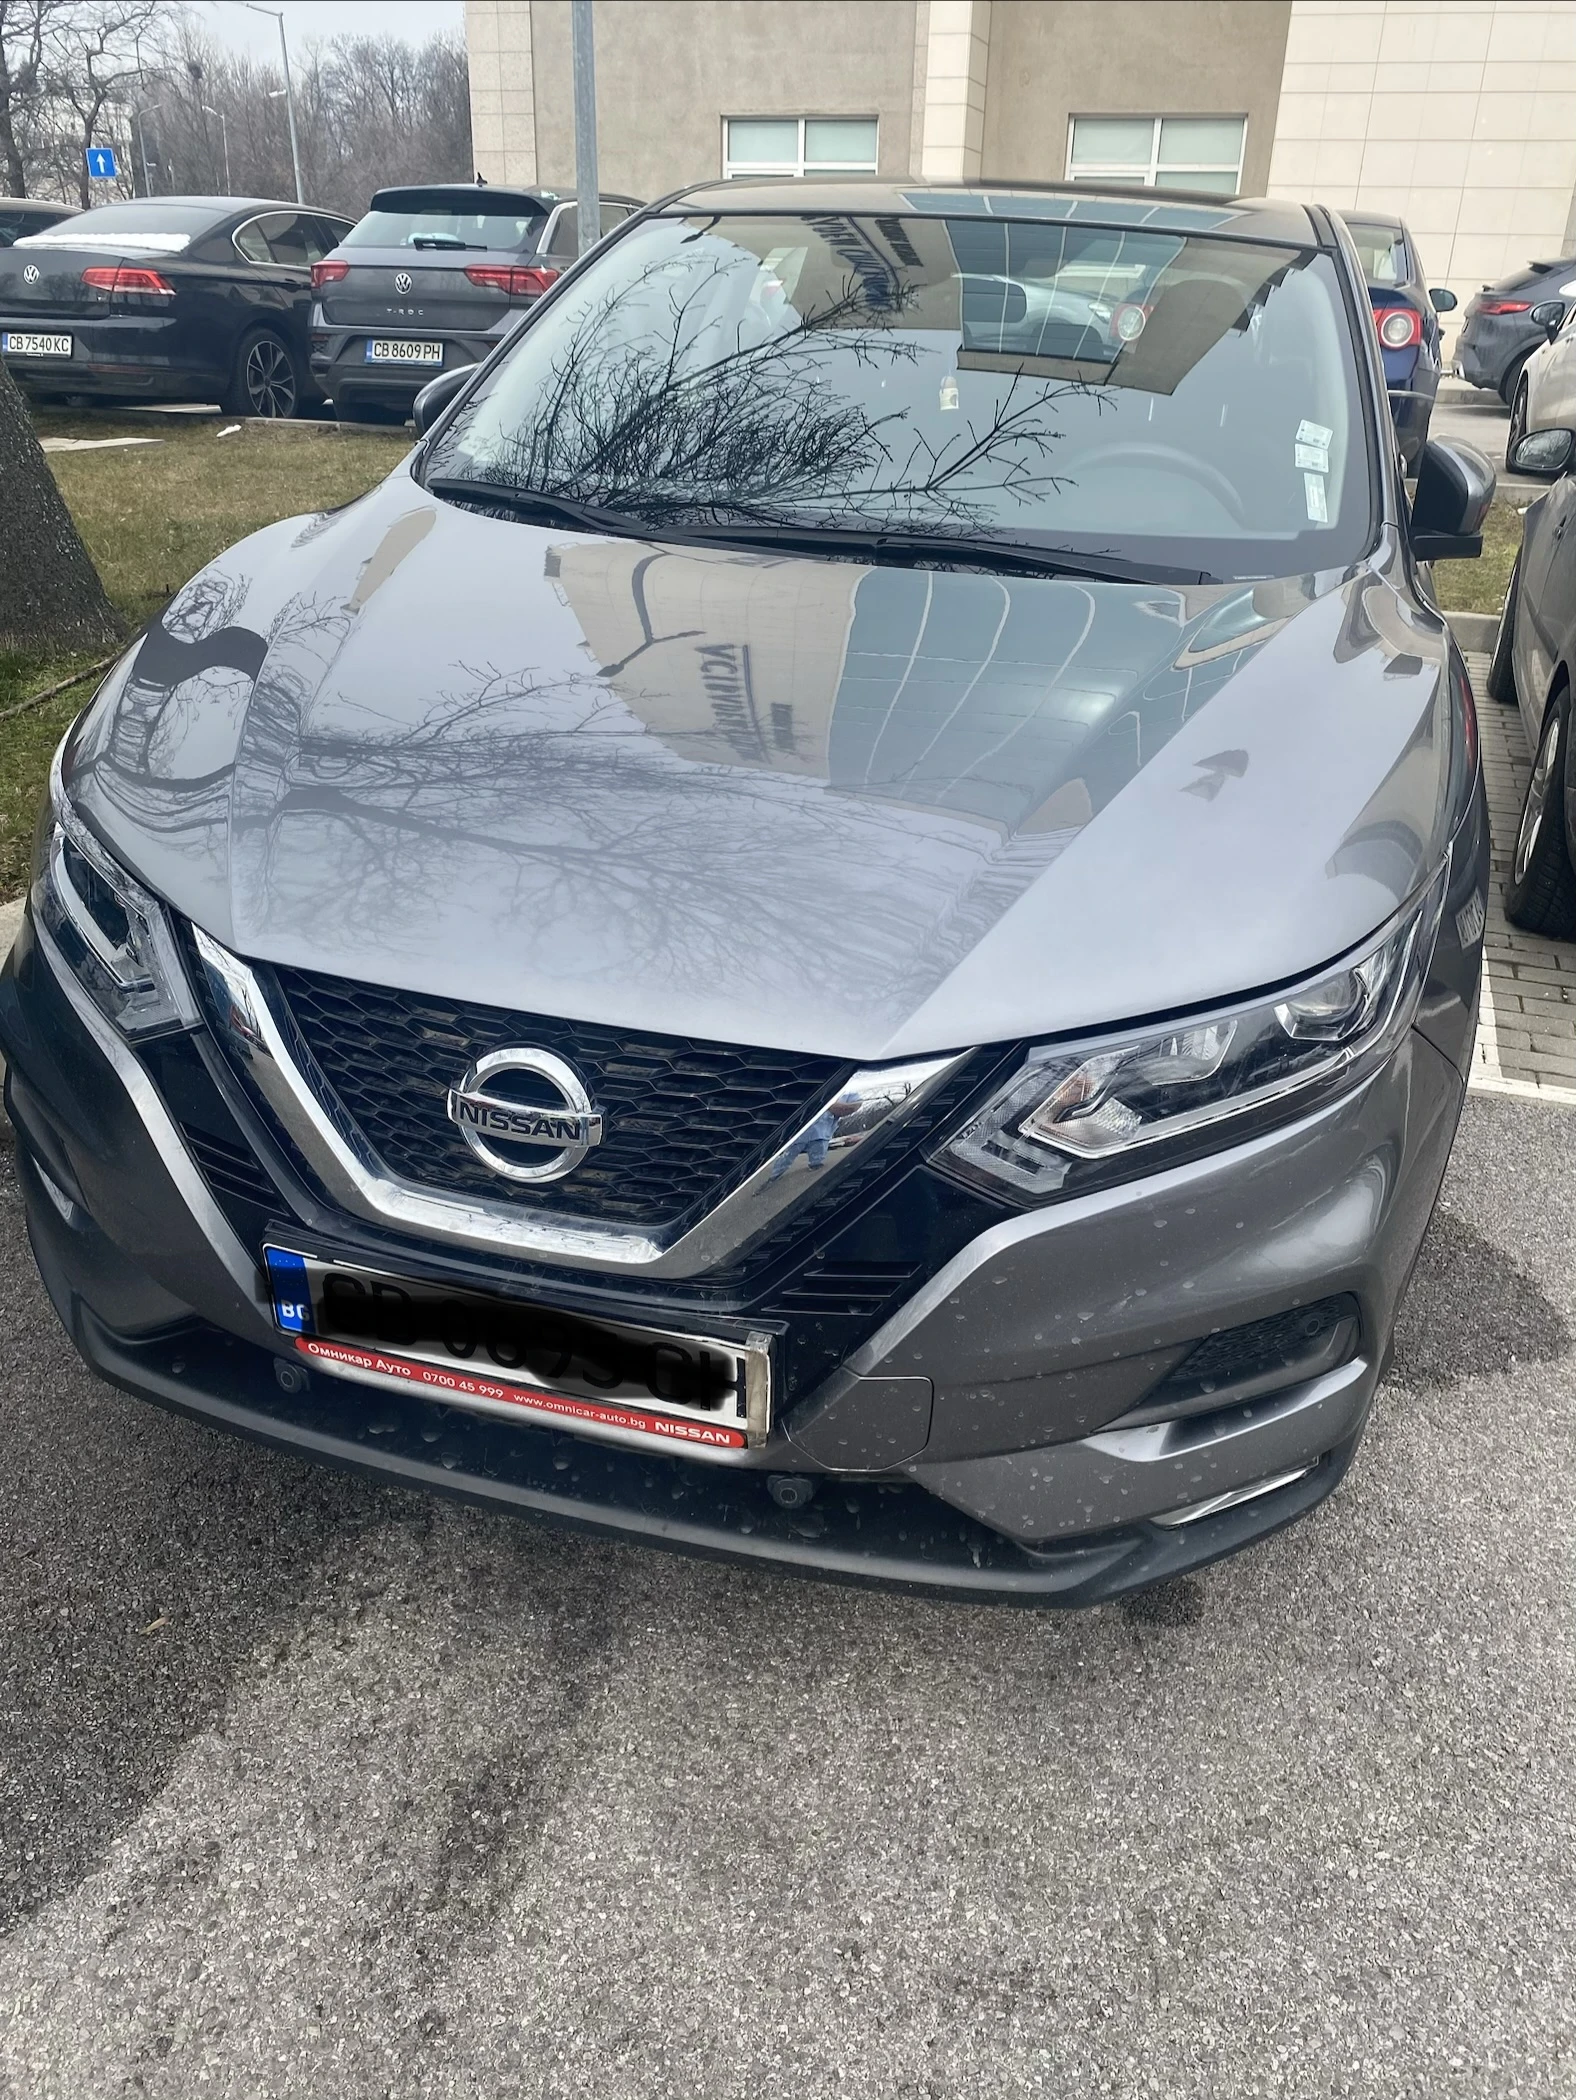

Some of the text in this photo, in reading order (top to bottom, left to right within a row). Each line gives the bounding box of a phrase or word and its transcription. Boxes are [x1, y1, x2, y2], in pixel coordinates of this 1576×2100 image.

[25, 336, 53, 352] 7540
[391, 343, 422, 359] 8609
[459, 1102, 581, 1141] NISSAN
[308, 1342, 730, 1444] Омникар Ауто 0700 45 999 www.omnicar-auto.bg NISSAN
